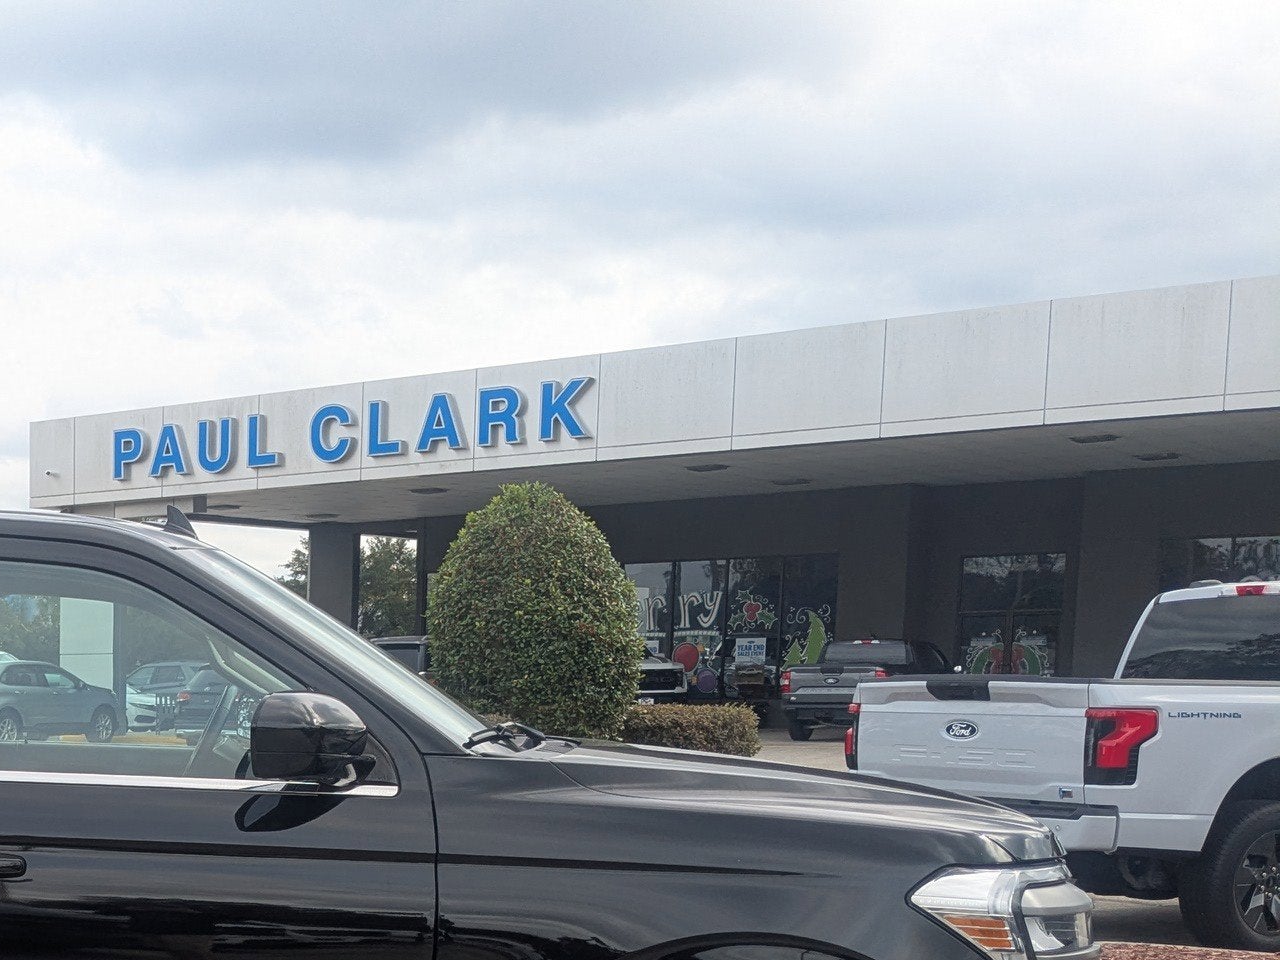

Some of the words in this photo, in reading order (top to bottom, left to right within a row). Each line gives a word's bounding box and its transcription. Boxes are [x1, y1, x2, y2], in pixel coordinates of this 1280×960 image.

[112, 413, 283, 481] PAUL
[309, 377, 595, 463] CLARK
[1168, 711, 1242, 720] LIGHTNING
[948, 722, 973, 738] Ford
